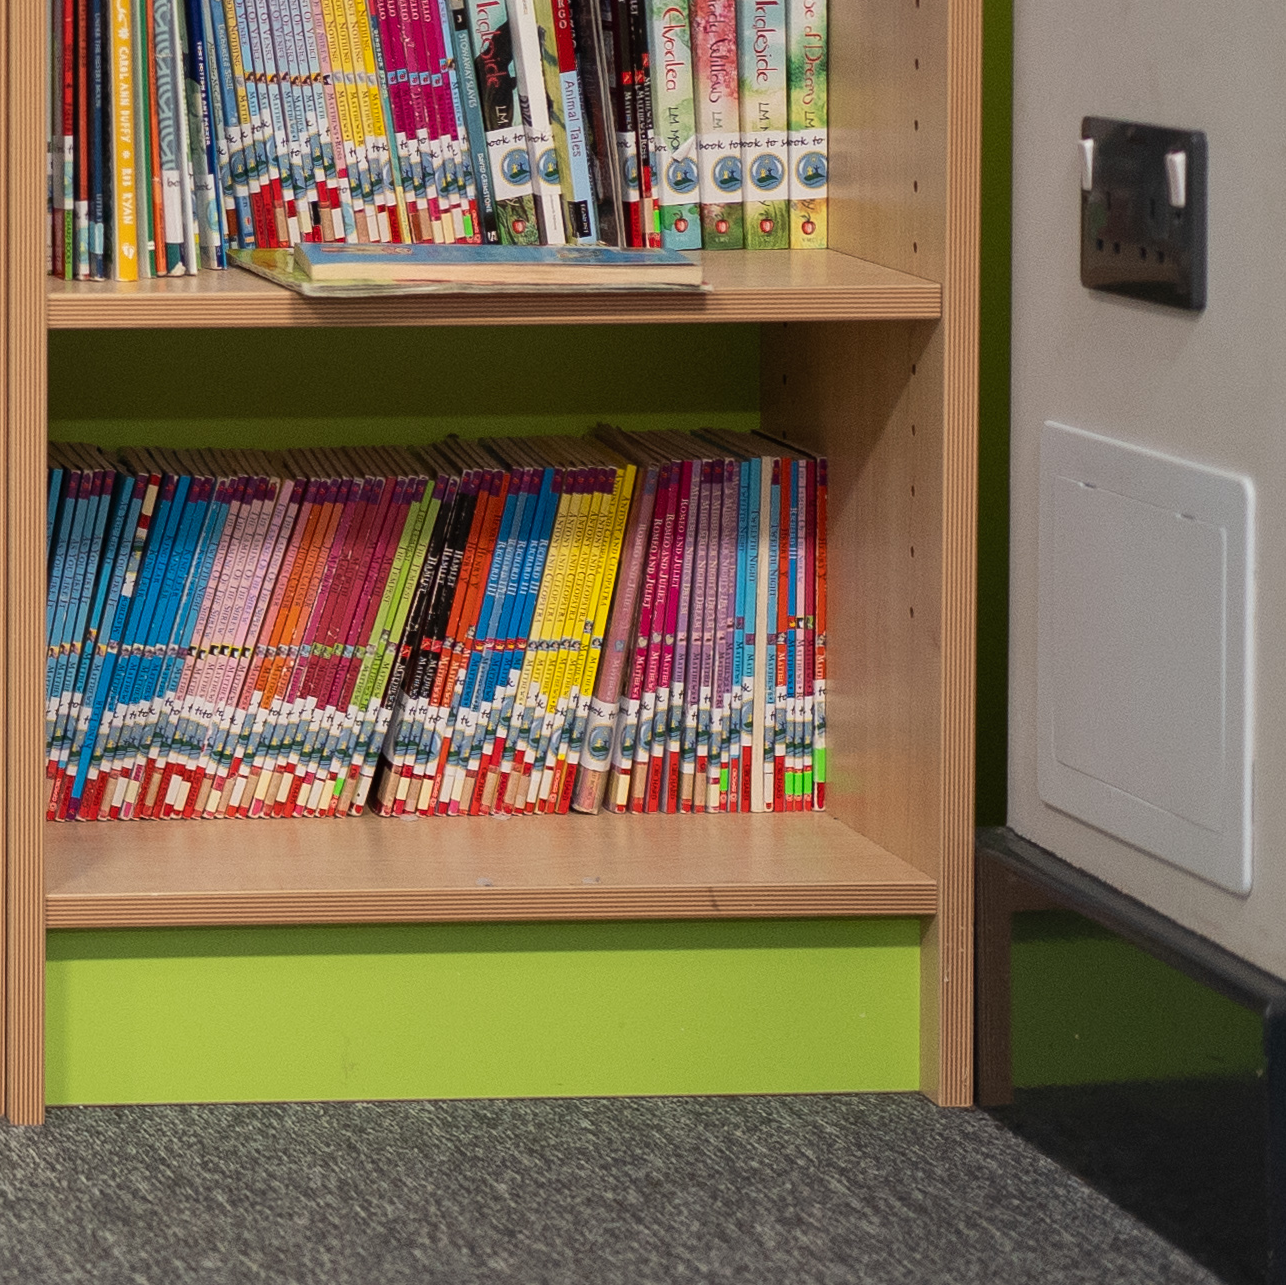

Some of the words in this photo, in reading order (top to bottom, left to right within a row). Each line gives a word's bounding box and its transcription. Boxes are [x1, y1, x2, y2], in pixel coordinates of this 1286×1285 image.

[662, 7, 686, 92] Avonlea
[565, 79, 578, 125] Animal
[569, 126, 582, 157] Tales
[648, 517, 663, 553] ROMEO
[488, 540, 504, 583] RICHARD
[646, 555, 658, 574] AND
